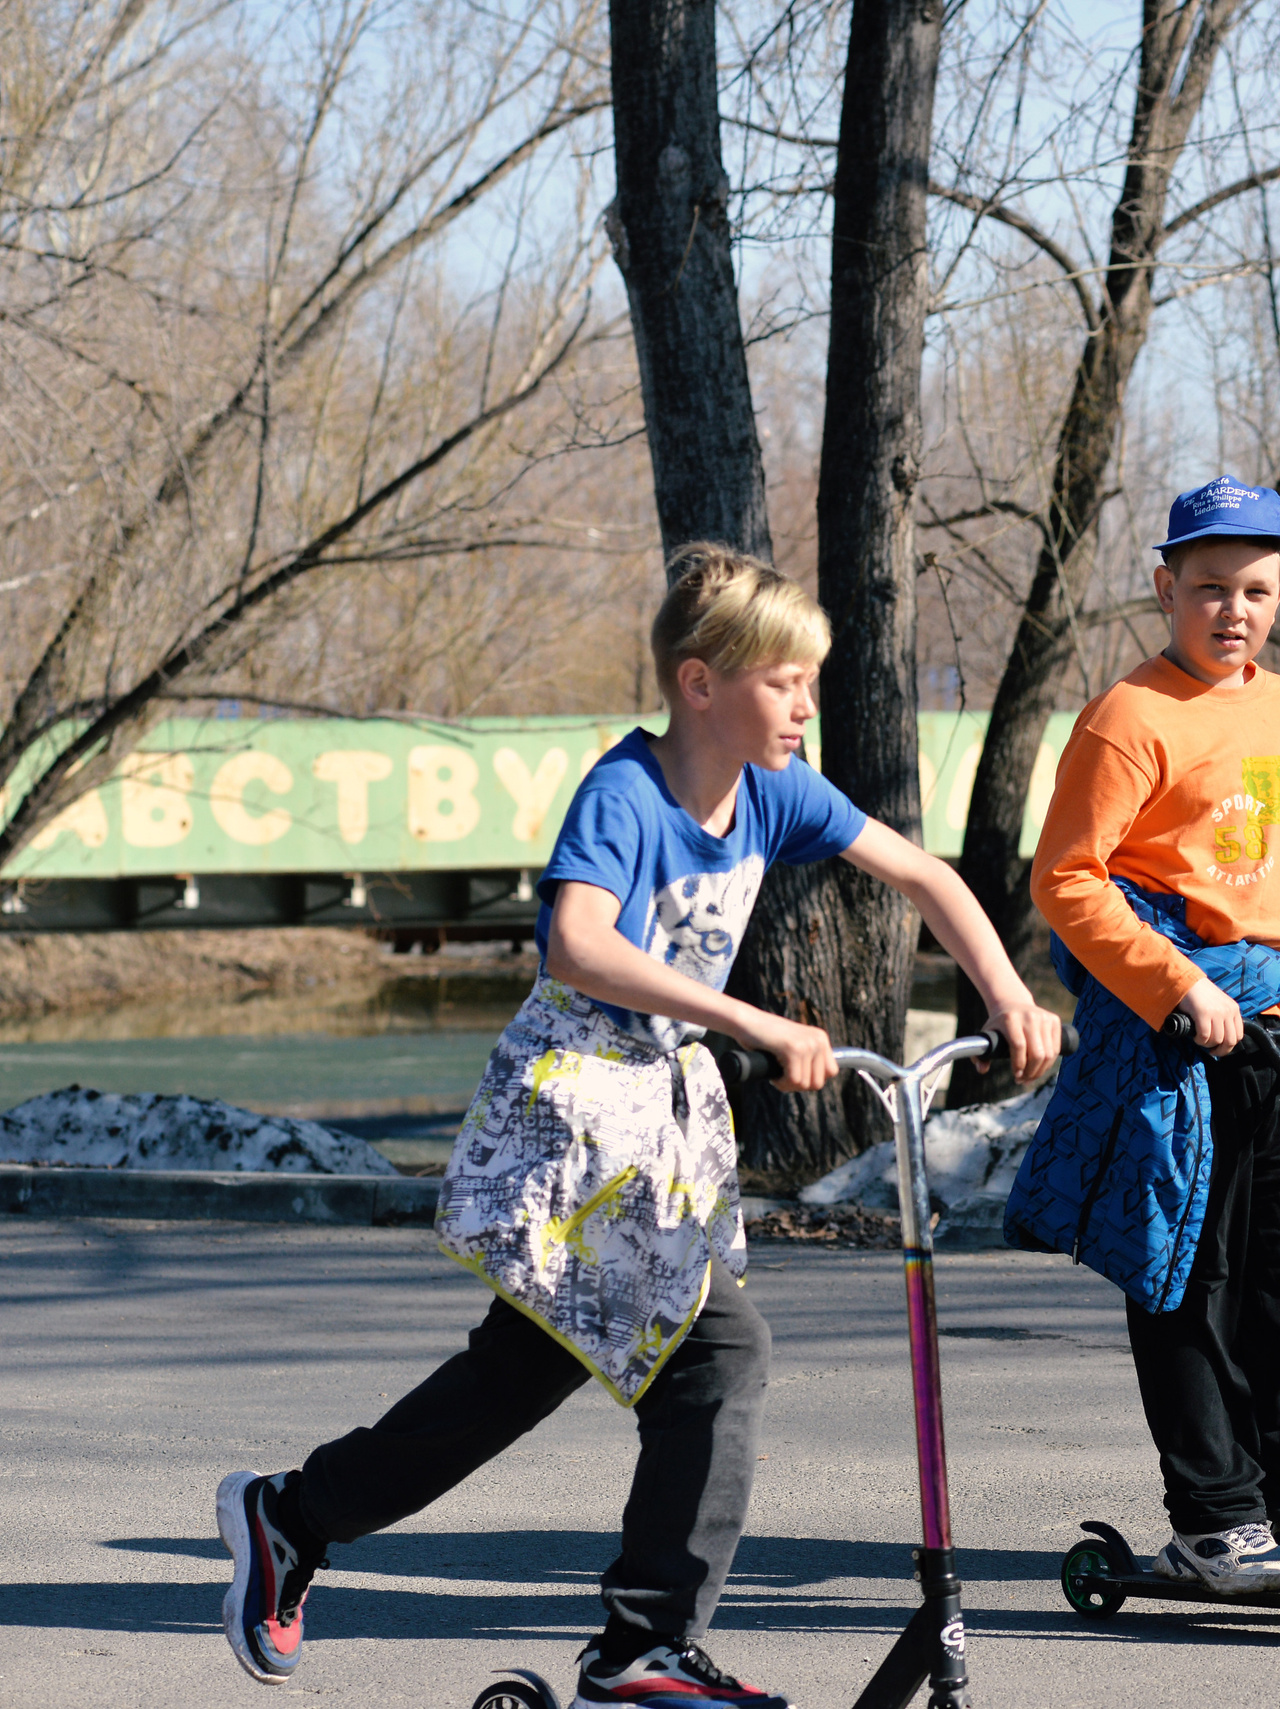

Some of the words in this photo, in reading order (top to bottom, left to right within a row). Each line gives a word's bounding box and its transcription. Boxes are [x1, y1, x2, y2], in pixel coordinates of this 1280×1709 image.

[1210, 478, 1230, 487] Café
[1201, 487, 1260, 500] PAARDEPUT
[1195, 501, 1240, 516] Liedekerke
[1211, 794, 1266, 823] SPORT
[1214, 824, 1268, 863] 58
